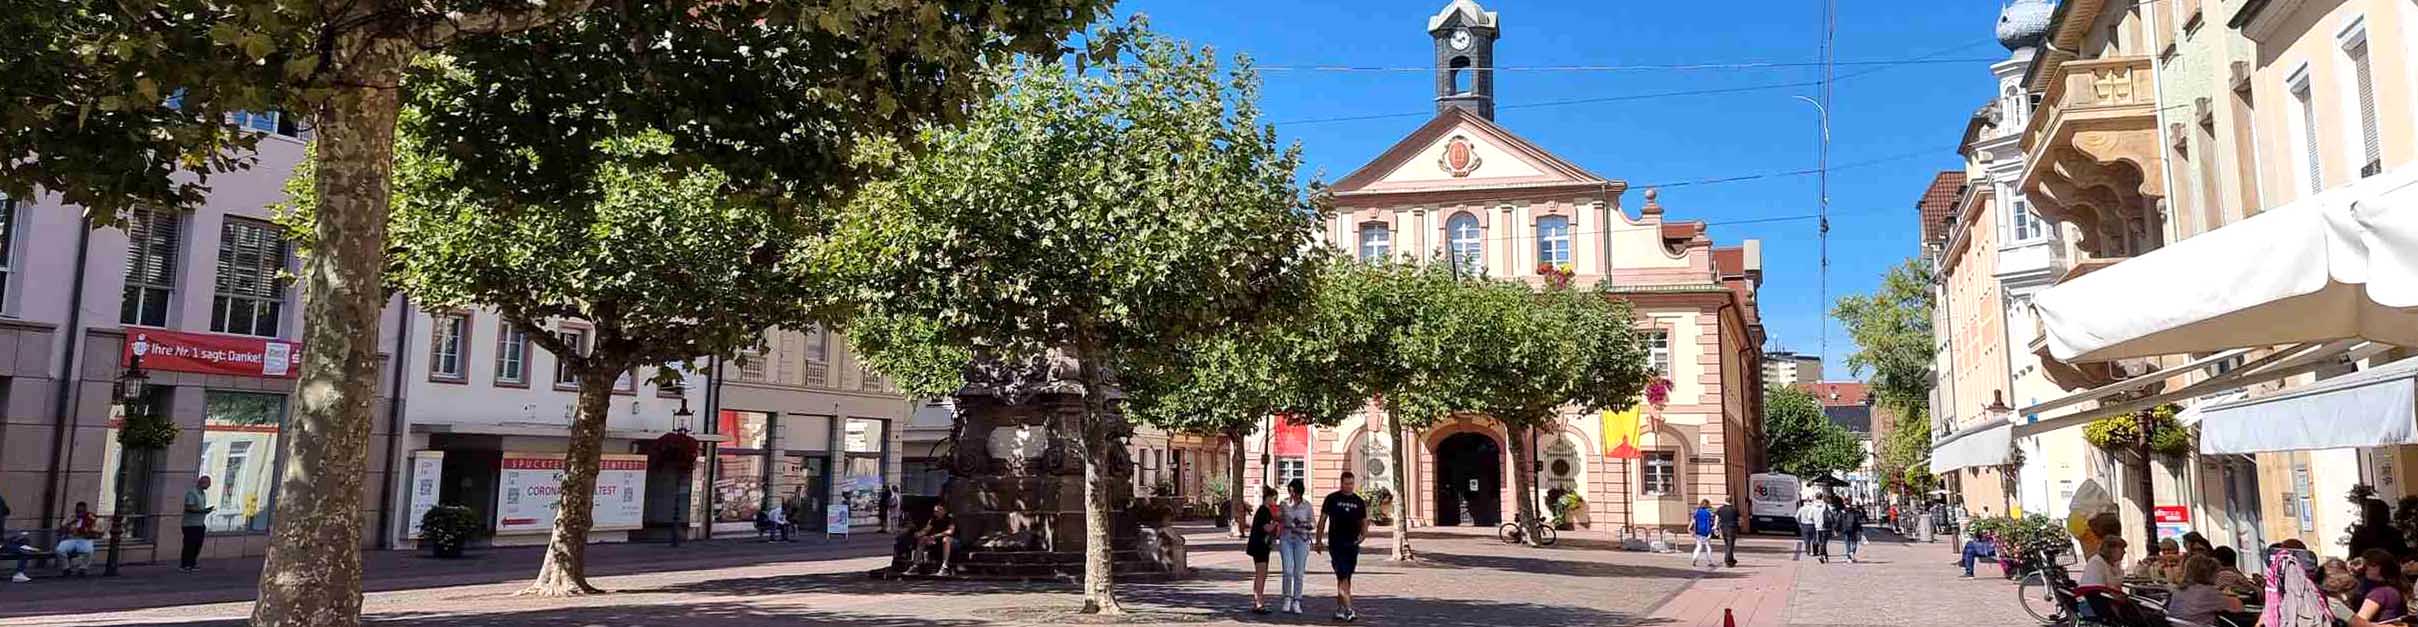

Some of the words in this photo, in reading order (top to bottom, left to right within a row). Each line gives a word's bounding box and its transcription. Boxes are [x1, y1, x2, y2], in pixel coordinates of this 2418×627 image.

[151, 343, 174, 356] Ihre
[174, 346, 190, 358] Nr.
[192, 347, 198, 358] 1
[201, 350, 226, 363] sagt:
[227, 352, 262, 363] Danke!
